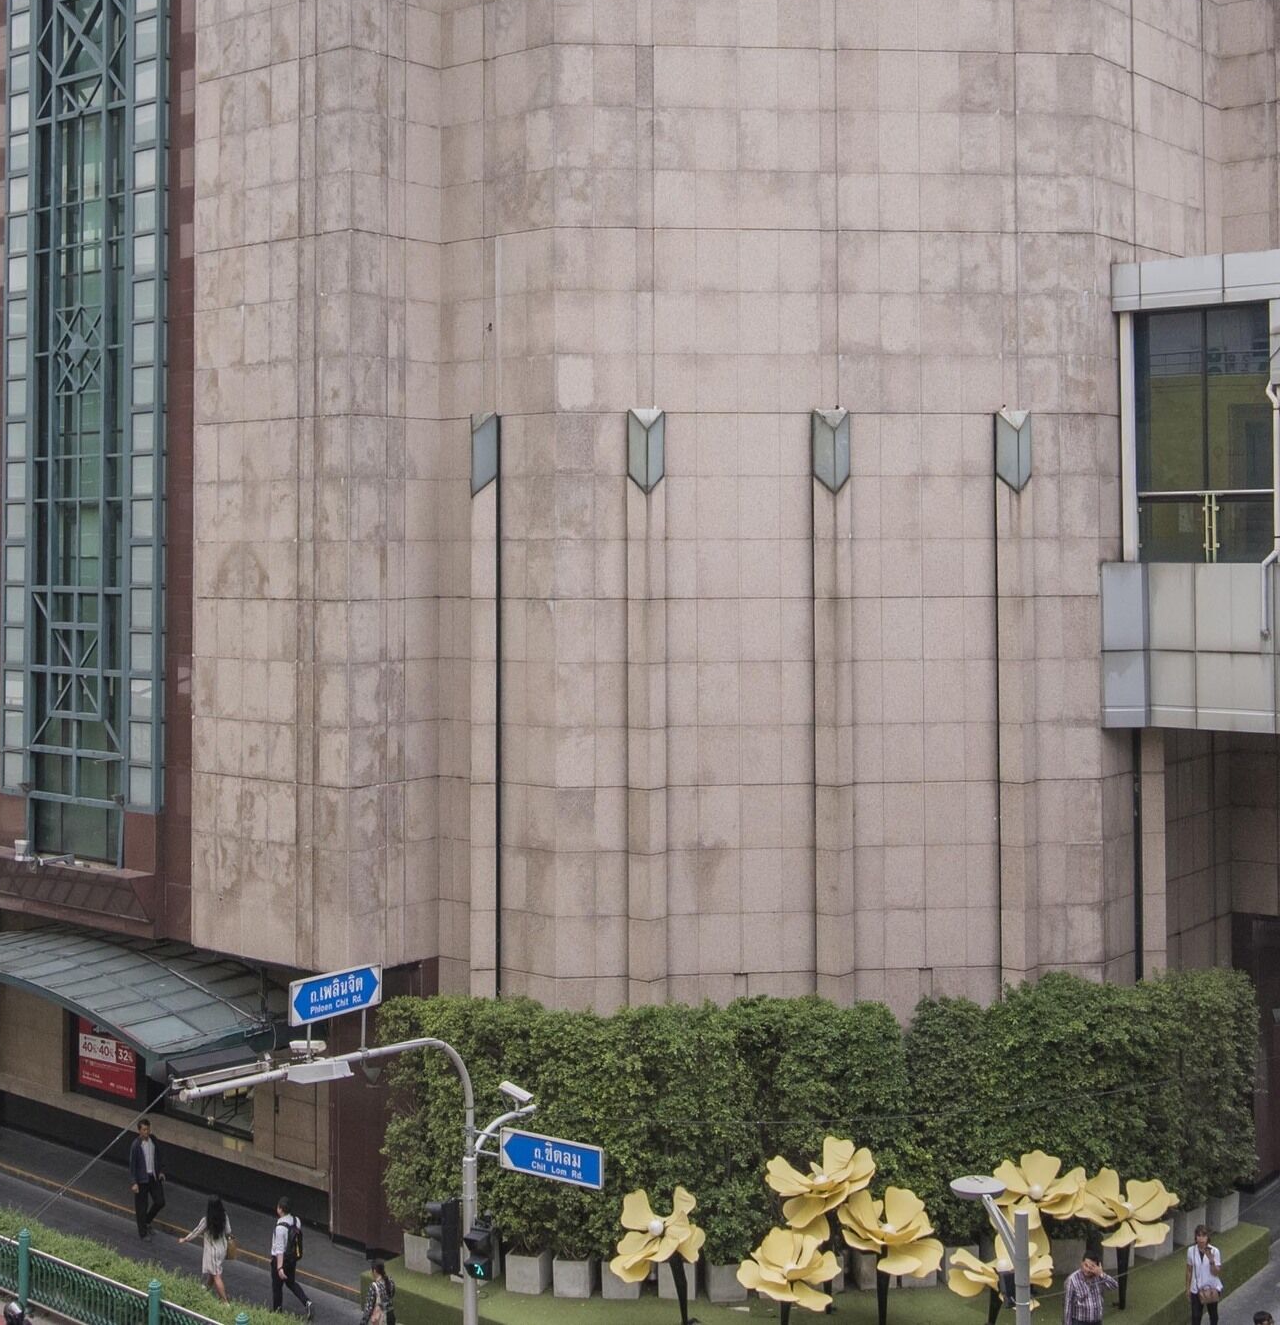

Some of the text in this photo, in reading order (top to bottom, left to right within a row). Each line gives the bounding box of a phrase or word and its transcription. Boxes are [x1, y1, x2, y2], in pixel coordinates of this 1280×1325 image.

[310, 974, 363, 1003] ถ.เพลินจิต
[310, 1002, 333, 1015] Phloen
[335, 998, 349, 1008] Chit
[534, 1141, 581, 1168] ถ.ชิดลม
[531, 1161, 546, 1172] Chit
[551, 1165, 567, 1176] Lom
